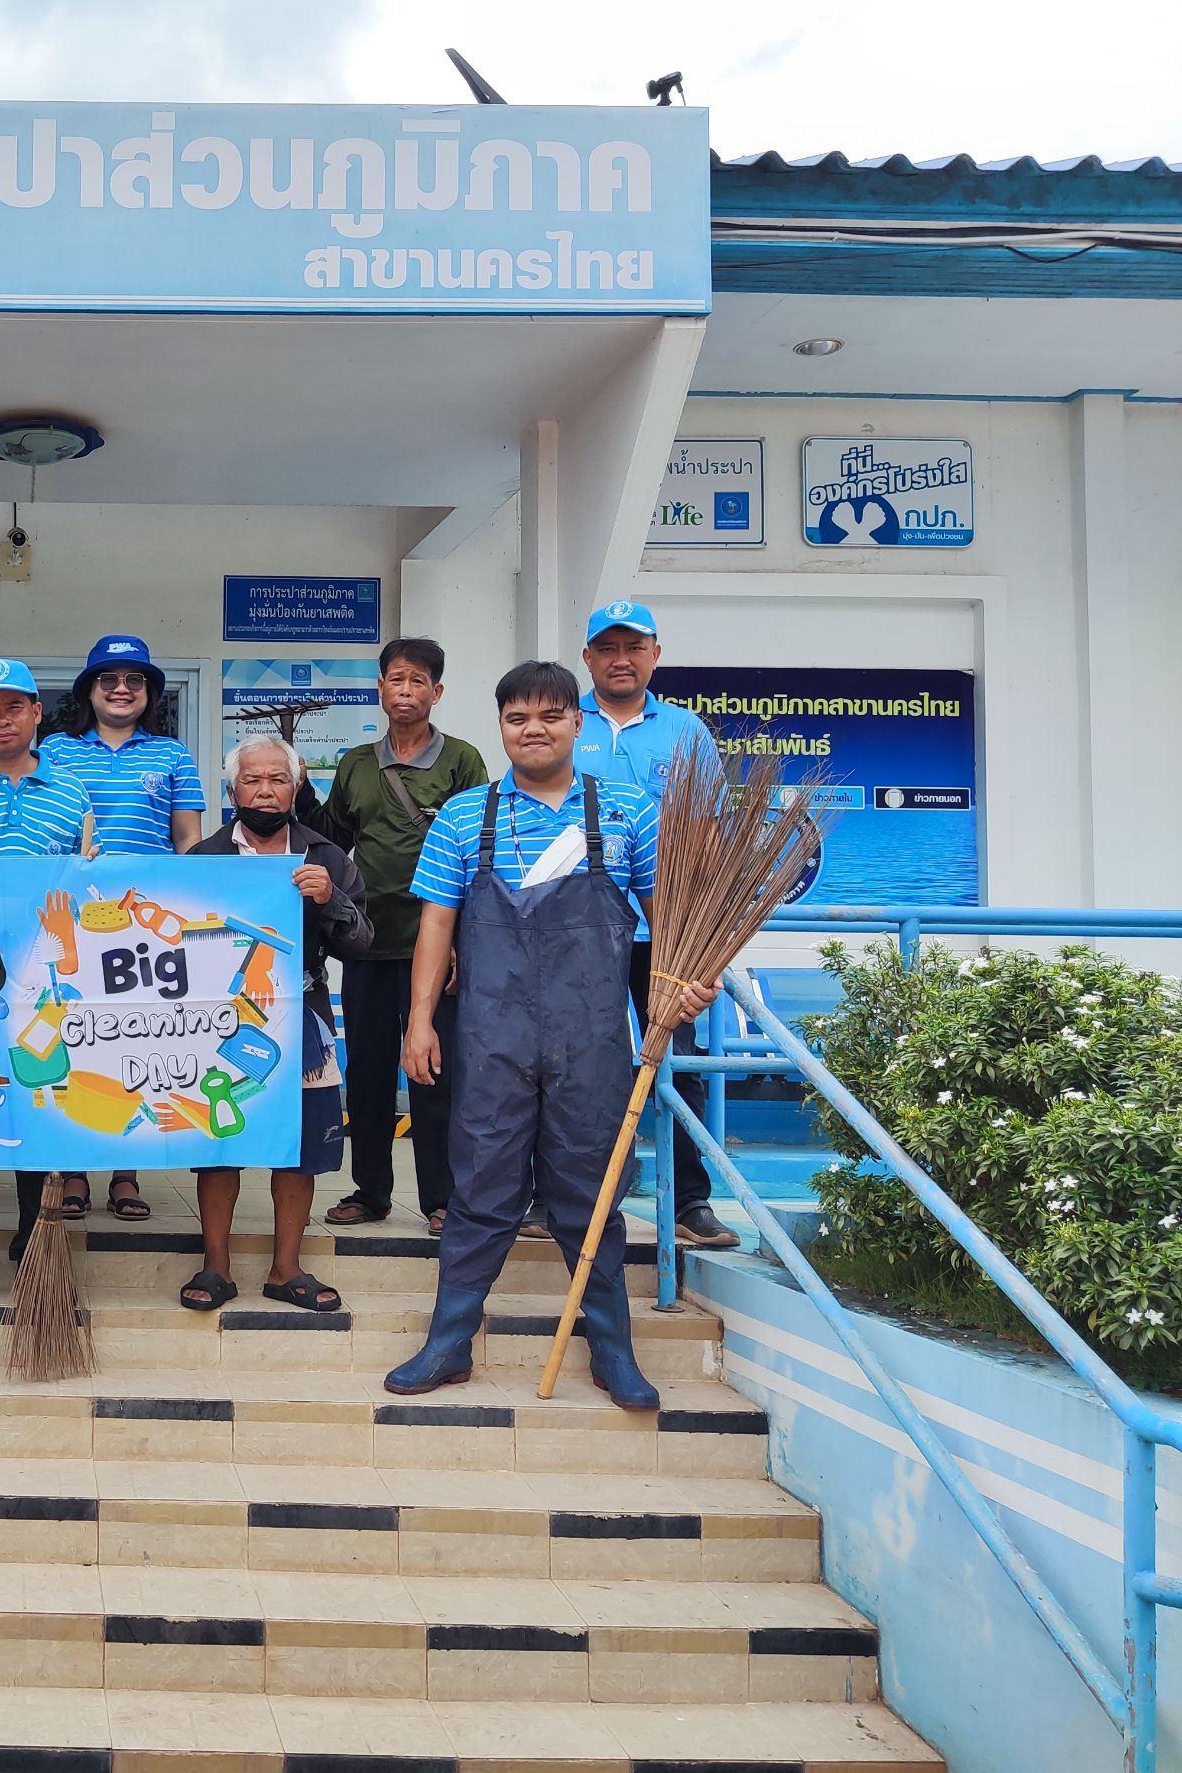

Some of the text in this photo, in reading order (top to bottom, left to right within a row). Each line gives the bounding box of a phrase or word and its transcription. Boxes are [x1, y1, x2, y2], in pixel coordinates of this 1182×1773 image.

[303, 229, 654, 290] สาขานครไทย
[904, 505, 965, 528] กปภ.
[249, 584, 355, 604] การประปาส่วนภูมิภาค
[248, 602, 355, 622] มุ่งมั่นป้องกันยาเสพติด
[580, 744, 601, 753] PWA
[914, 793, 962, 803] ข่าวภายนอก
[101, 942, 189, 1000] Big
[121, 1052, 198, 1093] DAY
